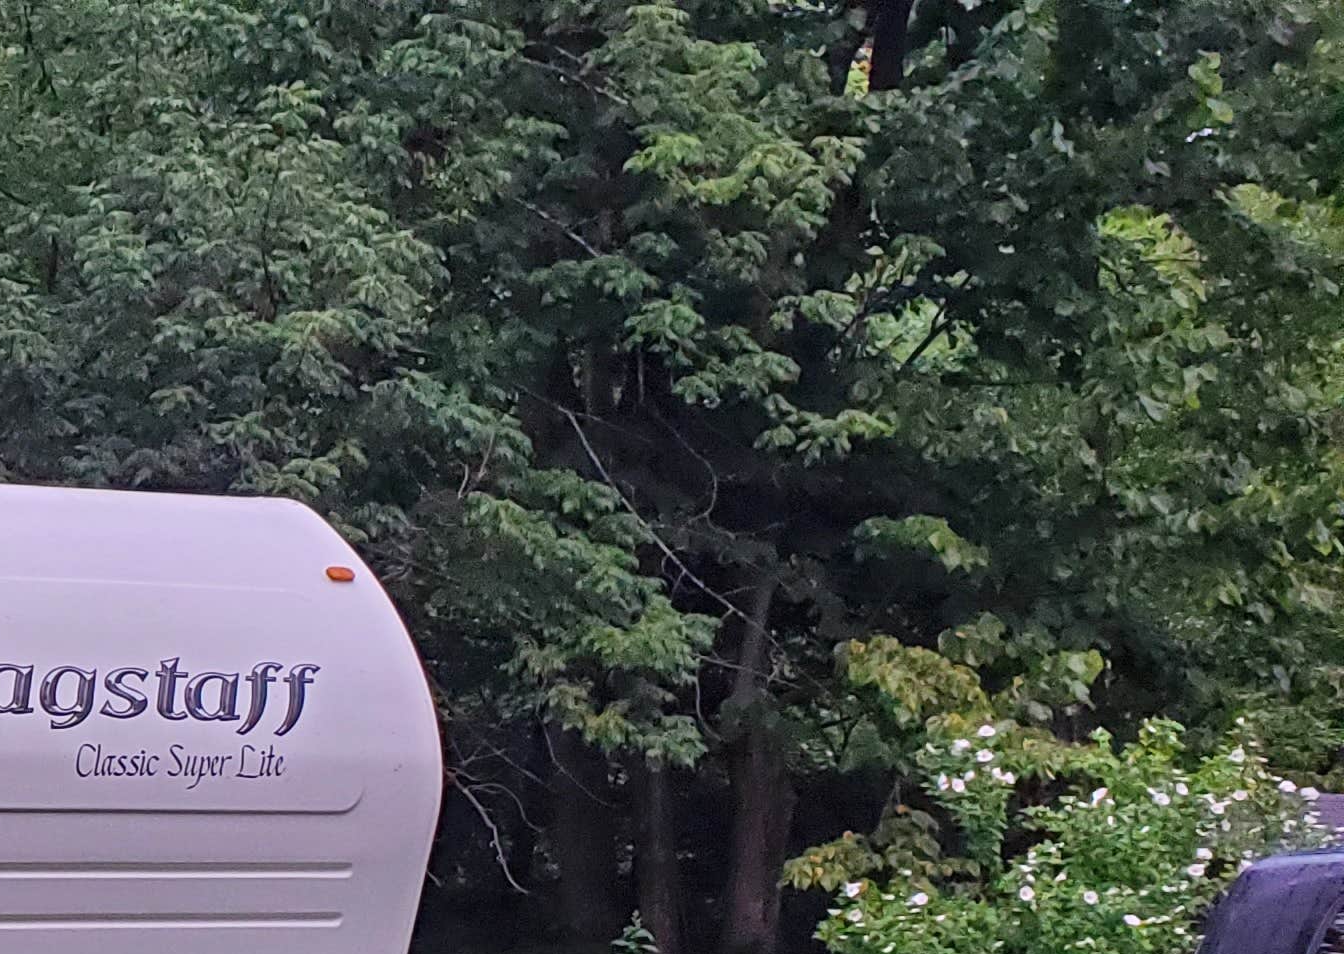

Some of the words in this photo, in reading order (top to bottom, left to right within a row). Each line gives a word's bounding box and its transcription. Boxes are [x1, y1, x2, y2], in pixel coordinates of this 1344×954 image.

[75, 743, 161, 778] Classic
[167, 743, 233, 790] Super
[234, 744, 287, 779] Lite
